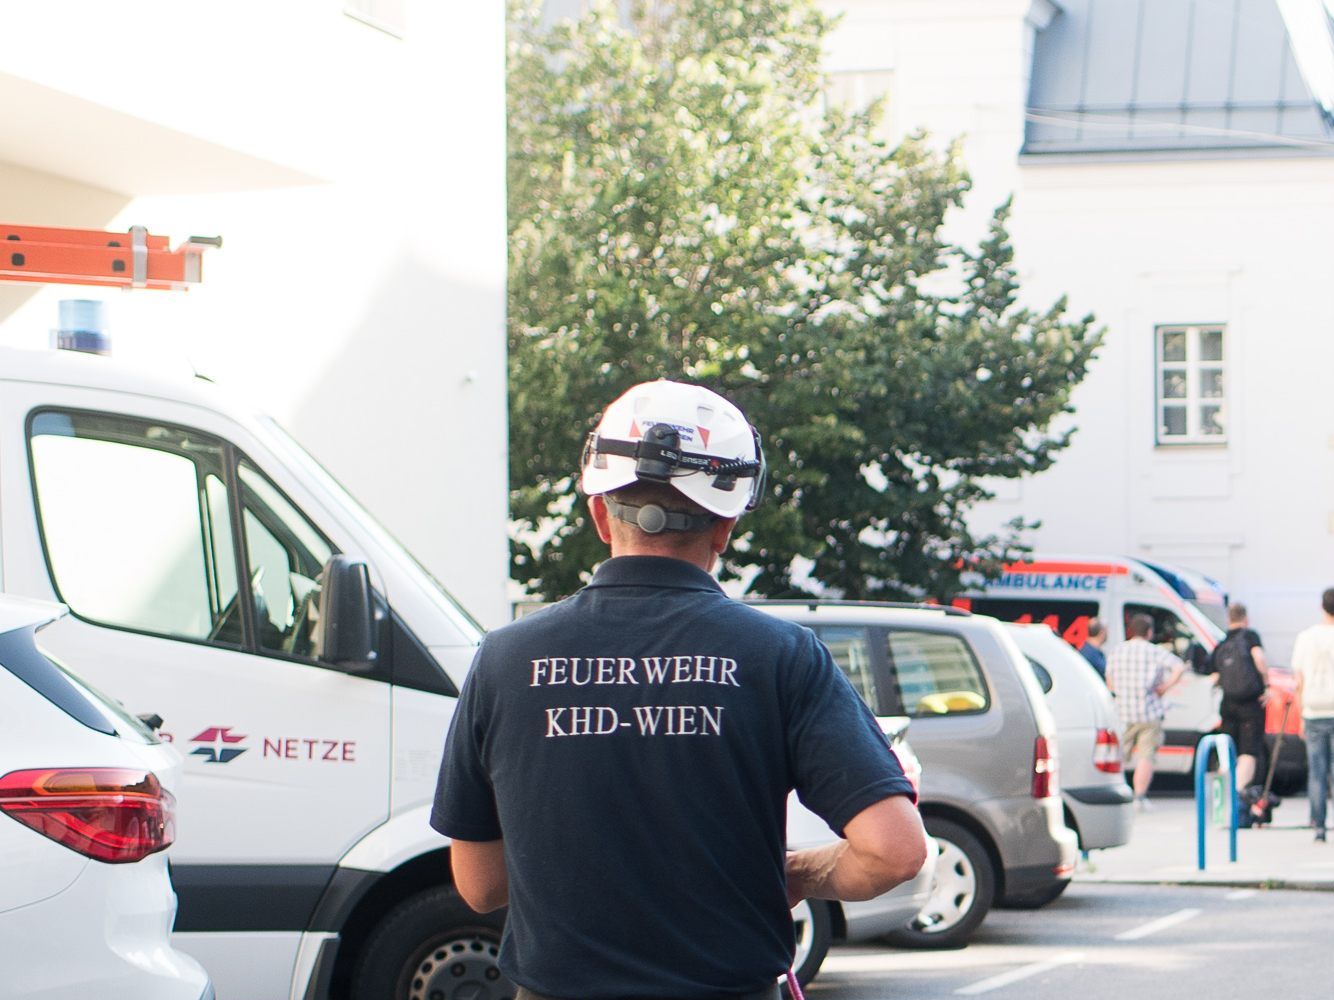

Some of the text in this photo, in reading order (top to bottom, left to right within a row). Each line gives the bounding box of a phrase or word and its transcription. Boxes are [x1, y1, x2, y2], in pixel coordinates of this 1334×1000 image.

[984, 573, 1108, 590] AMBULANCE
[529, 655, 741, 688] FEUERWEHR
[545, 705, 725, 738] KHD-WIEN
[263, 738, 356, 762] NETZE
